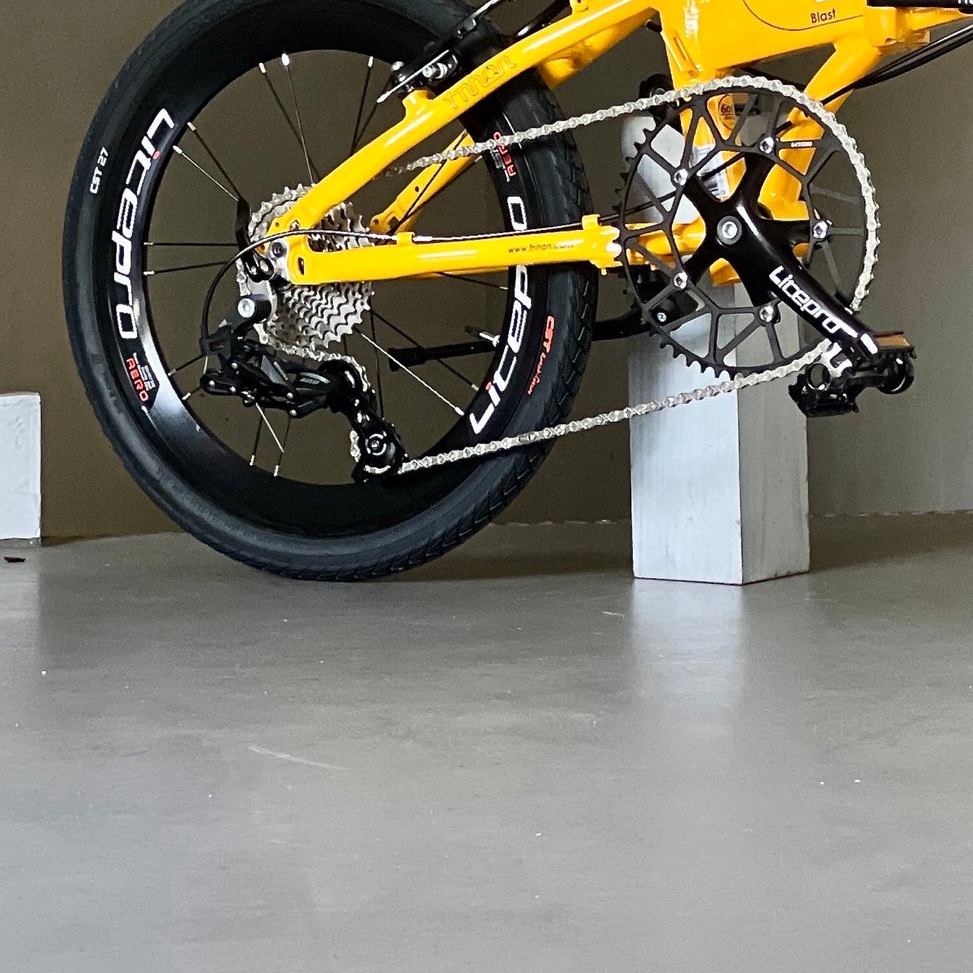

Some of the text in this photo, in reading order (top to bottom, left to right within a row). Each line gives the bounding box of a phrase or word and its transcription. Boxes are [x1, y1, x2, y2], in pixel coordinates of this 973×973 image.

[810, 8, 837, 24] Blast
[89, 146, 109, 195] CST 27
[112, 107, 175, 340] Litepro
[768, 265, 842, 334] Litepro
[126, 357, 149, 402] AERO
